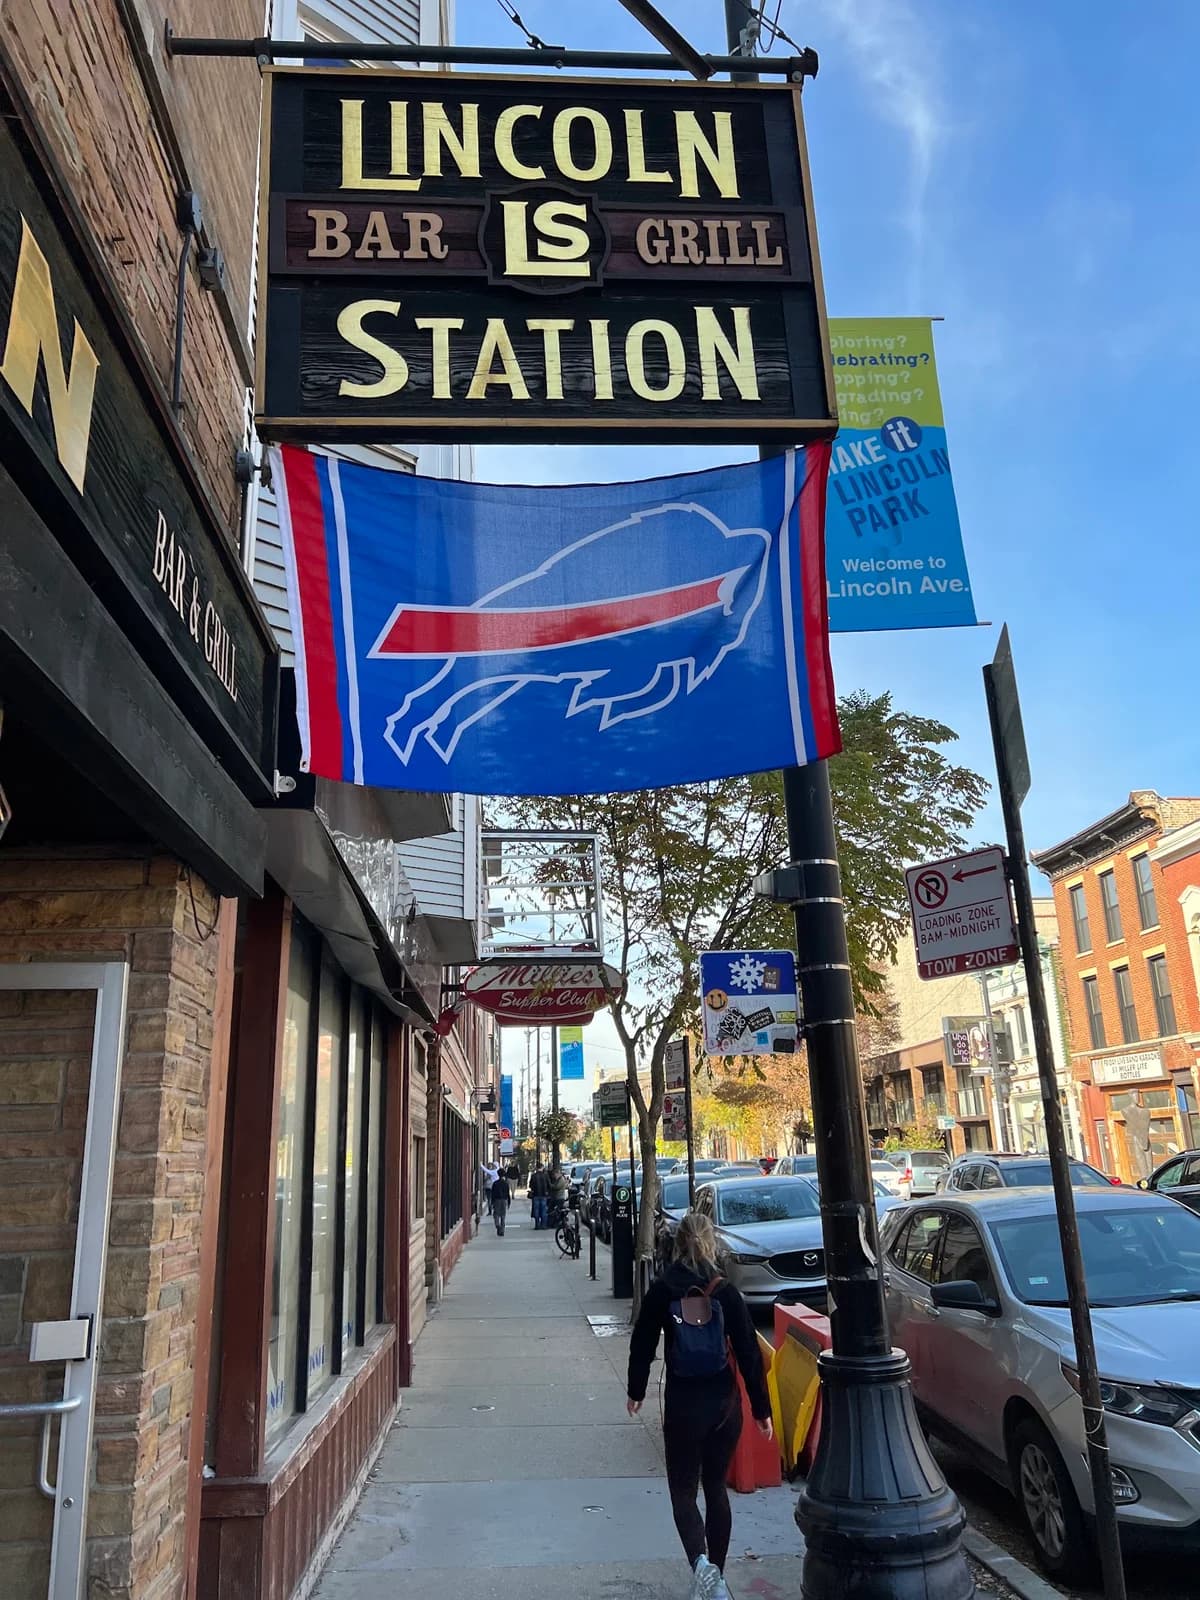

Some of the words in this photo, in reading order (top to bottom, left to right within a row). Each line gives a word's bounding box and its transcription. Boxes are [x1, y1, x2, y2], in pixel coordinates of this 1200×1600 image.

[339, 99, 741, 199] LINCOLN
[307, 209, 449, 260] BAR
[636, 217, 784, 266] GRILL
[501, 200, 591, 277] LS
[336, 300, 762, 402] STATION
[886, 420, 918, 452] it
[833, 447, 951, 506] LINCOLN
[846, 488, 930, 537] PARK
[826, 577, 912, 598] Lincoln
[920, 575, 970, 593] Ave.
[842, 558, 924, 572] Welcome
[928, 556, 947, 569] to
[152, 509, 186, 624] BAR
[189, 576, 201, 643] &
[204, 601, 238, 702] GRILL
[919, 912, 962, 931] LOADING
[968, 905, 996, 920] ZONE
[926, 956, 957, 976] TOW
[965, 947, 1008, 969] ZONE
[500, 991, 554, 1011] Supper
